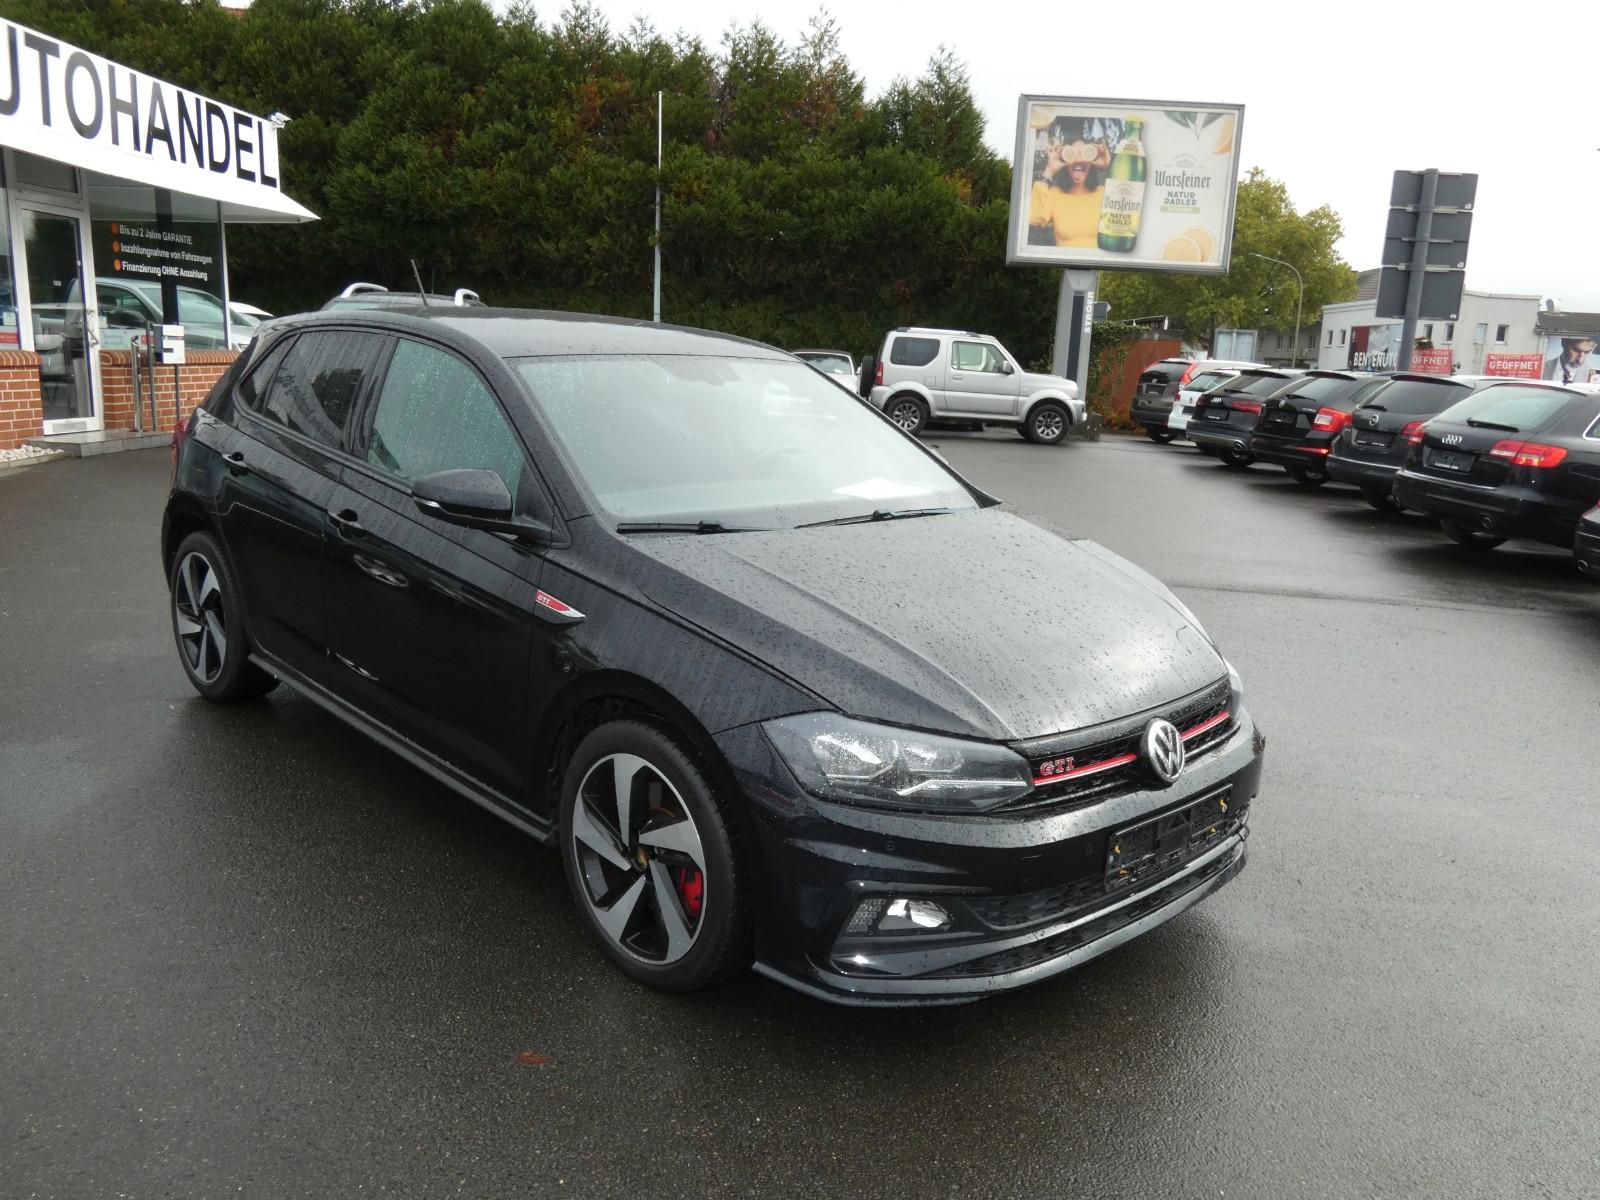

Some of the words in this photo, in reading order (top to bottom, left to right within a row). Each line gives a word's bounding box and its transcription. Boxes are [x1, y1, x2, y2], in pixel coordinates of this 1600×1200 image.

[1154, 169, 1212, 189] Warsteiner
[1164, 198, 1198, 206] RADLER
[1167, 191, 1196, 199] NATUR
[119, 224, 130, 236] Bis
[131, 228, 139, 237] zu
[139, 228, 145, 238] 2
[145, 229, 162, 241] Jahre
[162, 231, 193, 245] GARANTIE
[120, 242, 170, 258] Inzahlungnahme
[170, 251, 181, 259] von
[181, 251, 213, 265] Fahrzeugen
[122, 261, 162, 277] Finanzierung
[161, 265, 180, 276] OHNE
[180, 267, 208, 281] Anzahlung
[1412, 354, 1449, 366] ÖFFNET
[1489, 359, 1540, 370] GEÖFFNET
[537, 595, 550, 605] GTI
[1039, 756, 1075, 776] GTI
